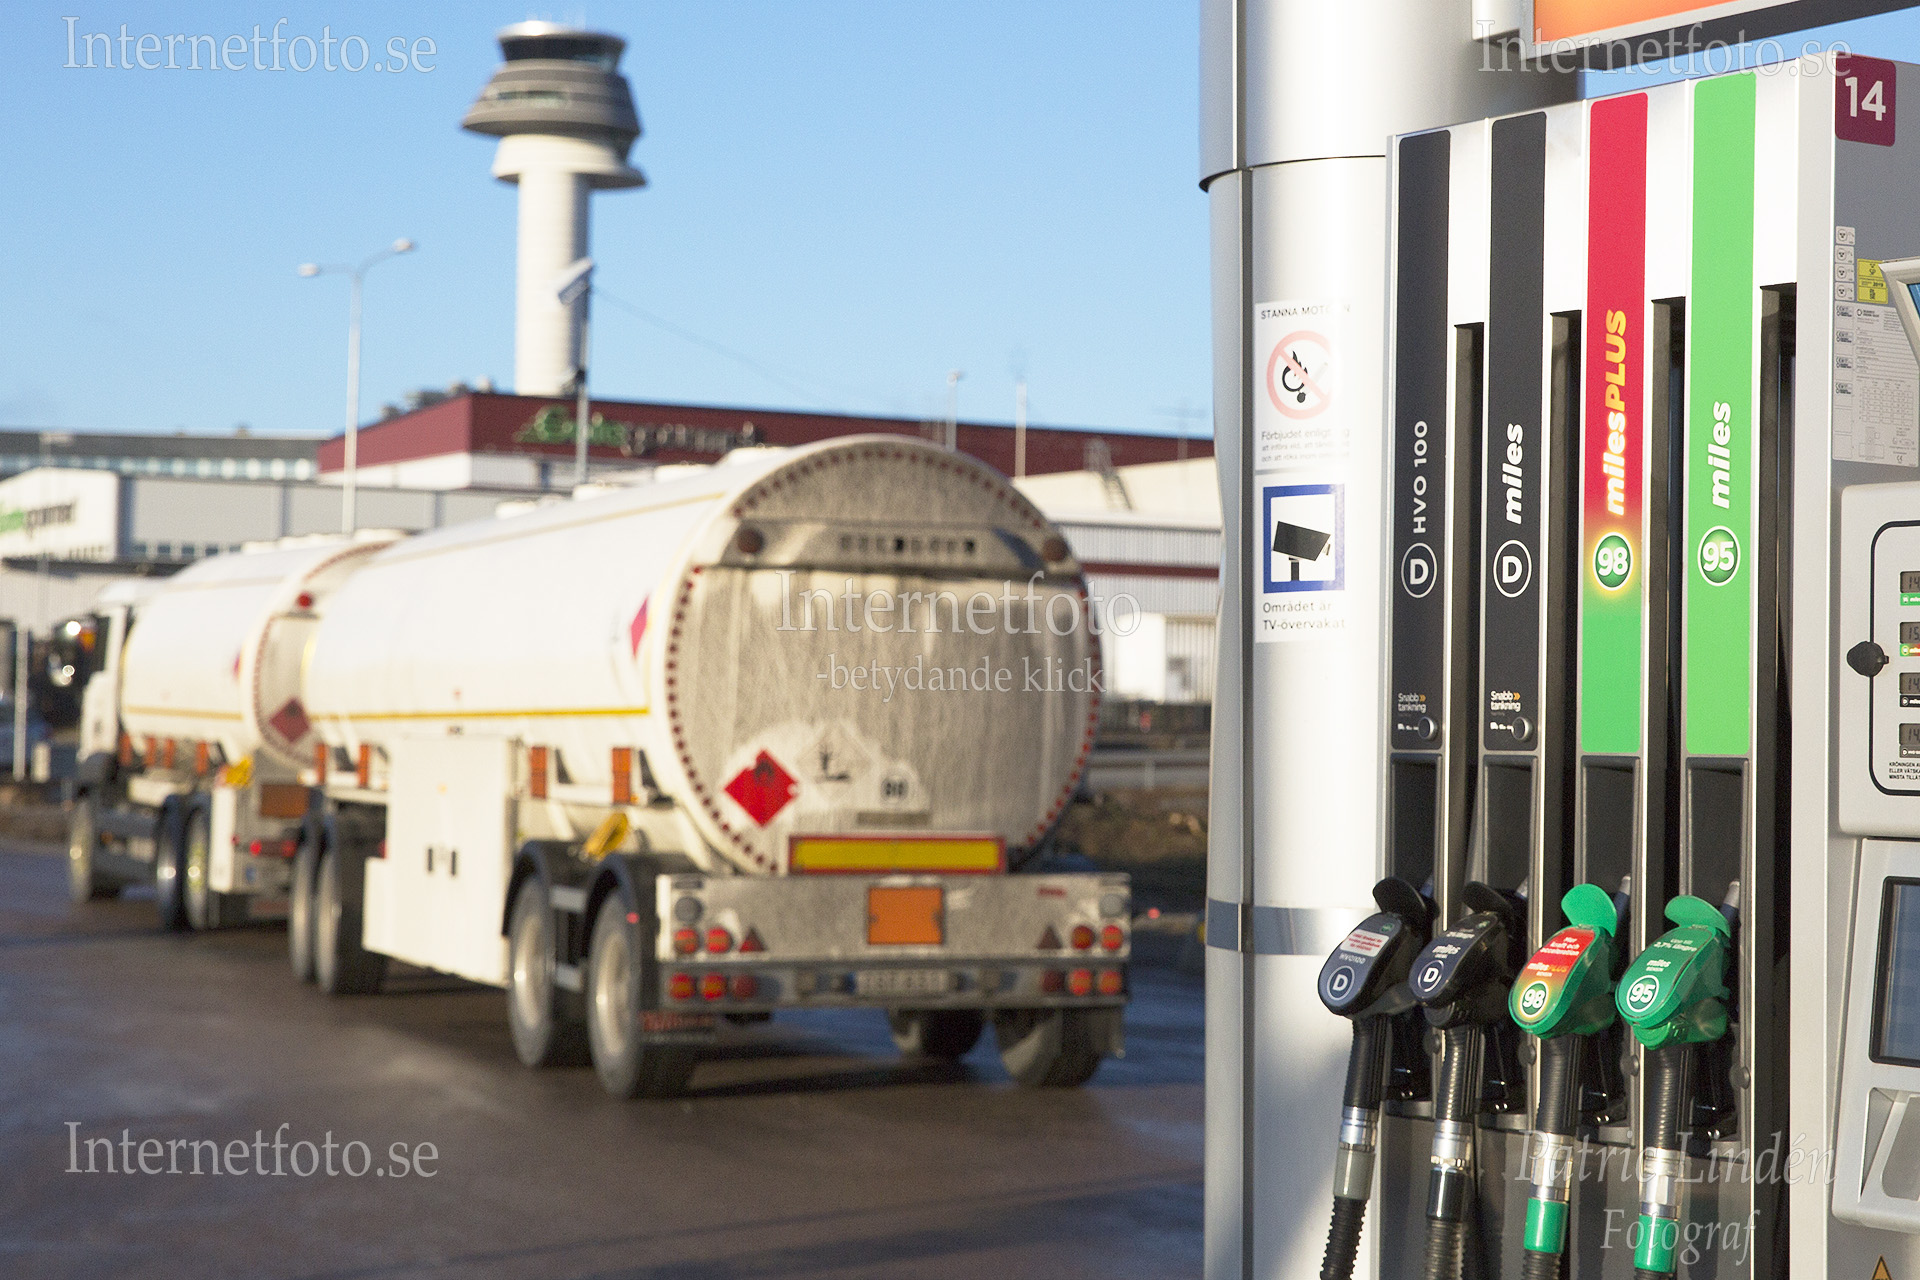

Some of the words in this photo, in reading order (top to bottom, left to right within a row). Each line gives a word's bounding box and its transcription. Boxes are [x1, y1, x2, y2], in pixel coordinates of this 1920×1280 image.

[1844, 76, 1887, 122] 14
[1261, 308, 1298, 320] STANNA
[1413, 420, 1429, 467] 100
[1707, 401, 1731, 510] miles
[1502, 423, 1524, 525] miles
[1413, 475, 1428, 534] HVO
[1597, 546, 1628, 577] 98
[1702, 540, 1736, 573] 95
[1409, 558, 1429, 586] D
[1502, 555, 1523, 584] D
[1263, 601, 1315, 614] Området
[1397, 692, 1420, 703] Snabb
[1490, 690, 1514, 702] Snabb
[1397, 702, 1427, 714] tankning
[1490, 701, 1521, 713] tankning
[1332, 973, 1349, 992] D
[1423, 967, 1440, 983] D
[1522, 988, 1546, 1009] 98
[1629, 983, 1656, 1004] 95
